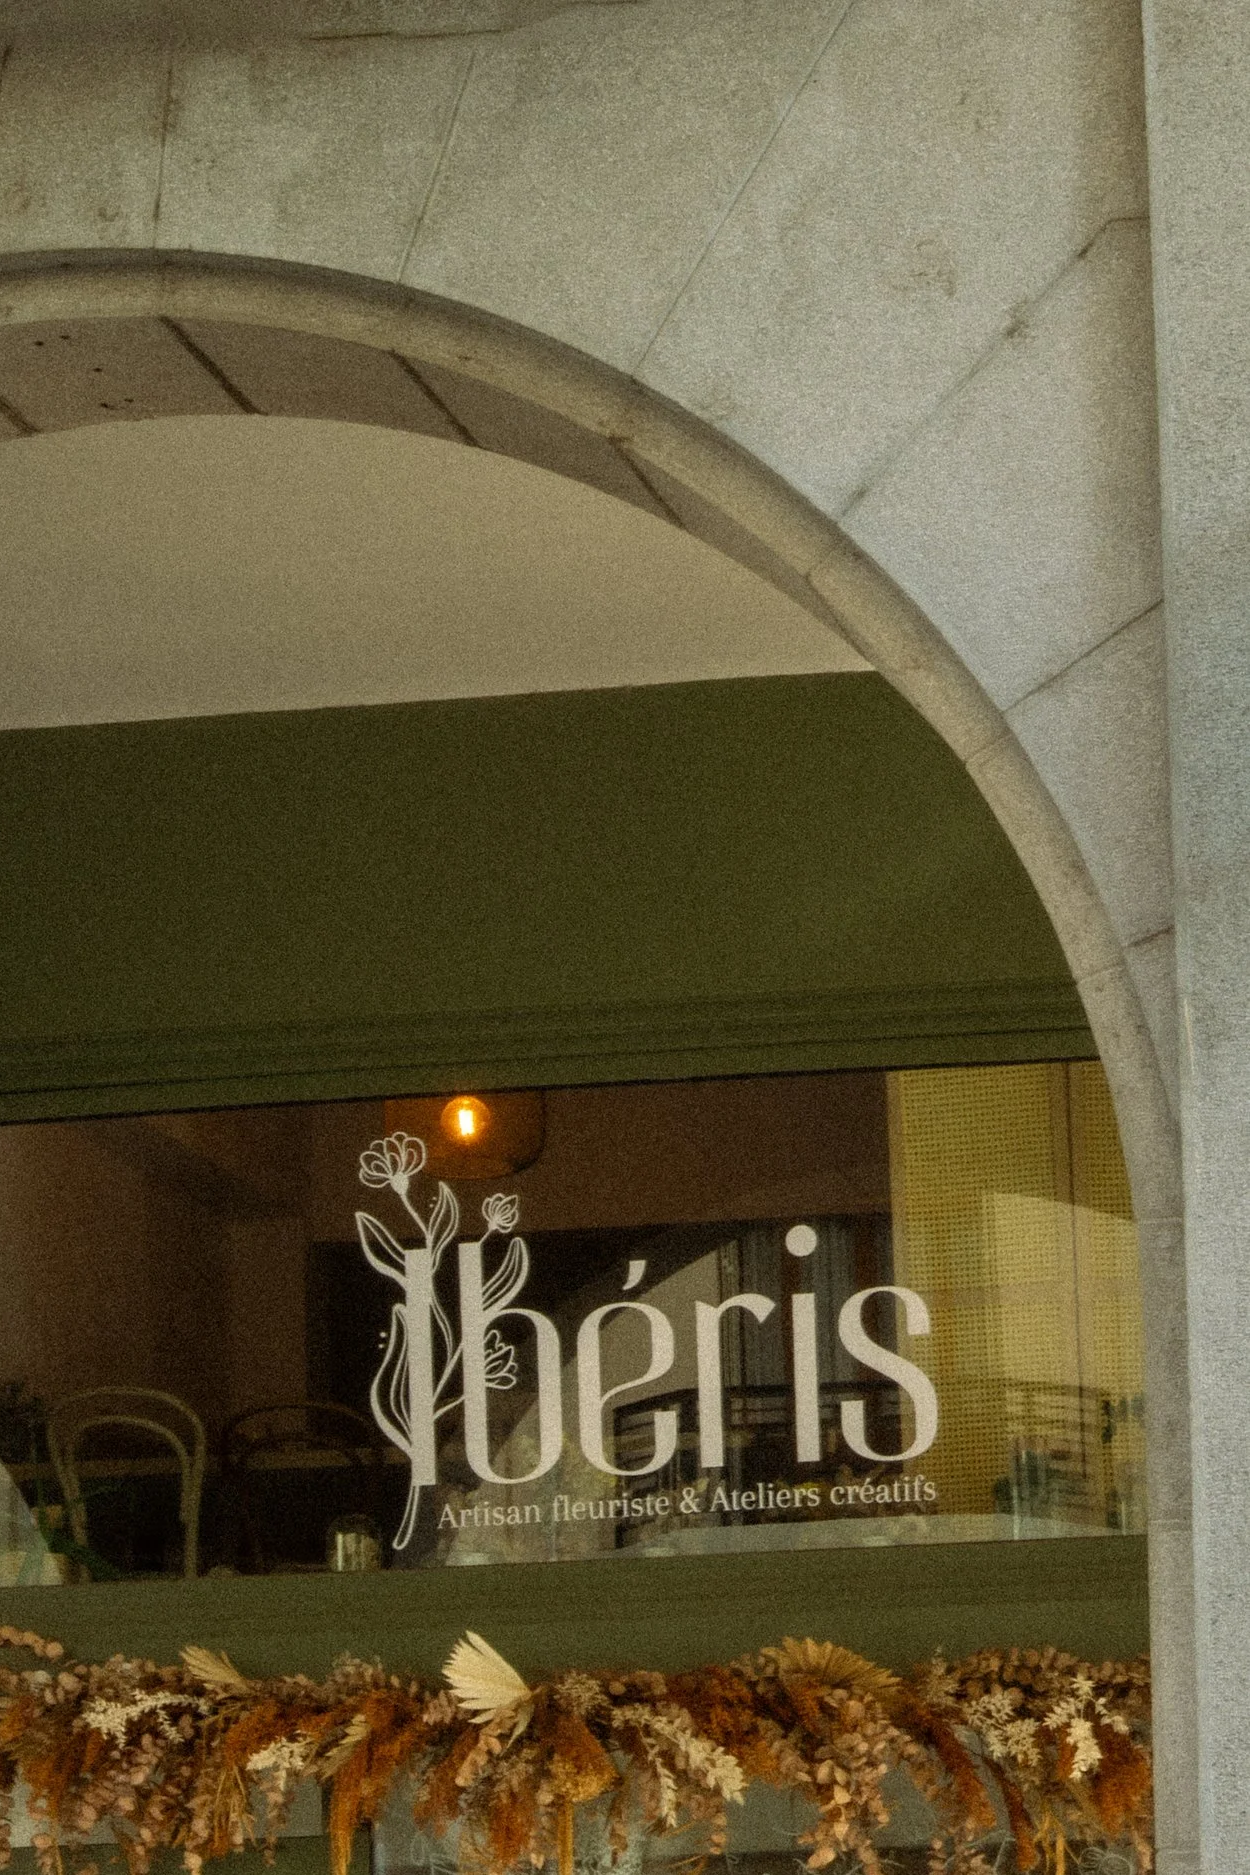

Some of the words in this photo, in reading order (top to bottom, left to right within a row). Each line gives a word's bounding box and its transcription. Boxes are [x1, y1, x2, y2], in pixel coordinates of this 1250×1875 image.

[405, 1225, 939, 1486] Ibéris
[437, 1499, 541, 1530] Artisan
[553, 1493, 670, 1523] fleuriste
[679, 1489, 702, 1513] &
[709, 1482, 820, 1513] Ateliers
[829, 1478, 937, 1506] créatifs
